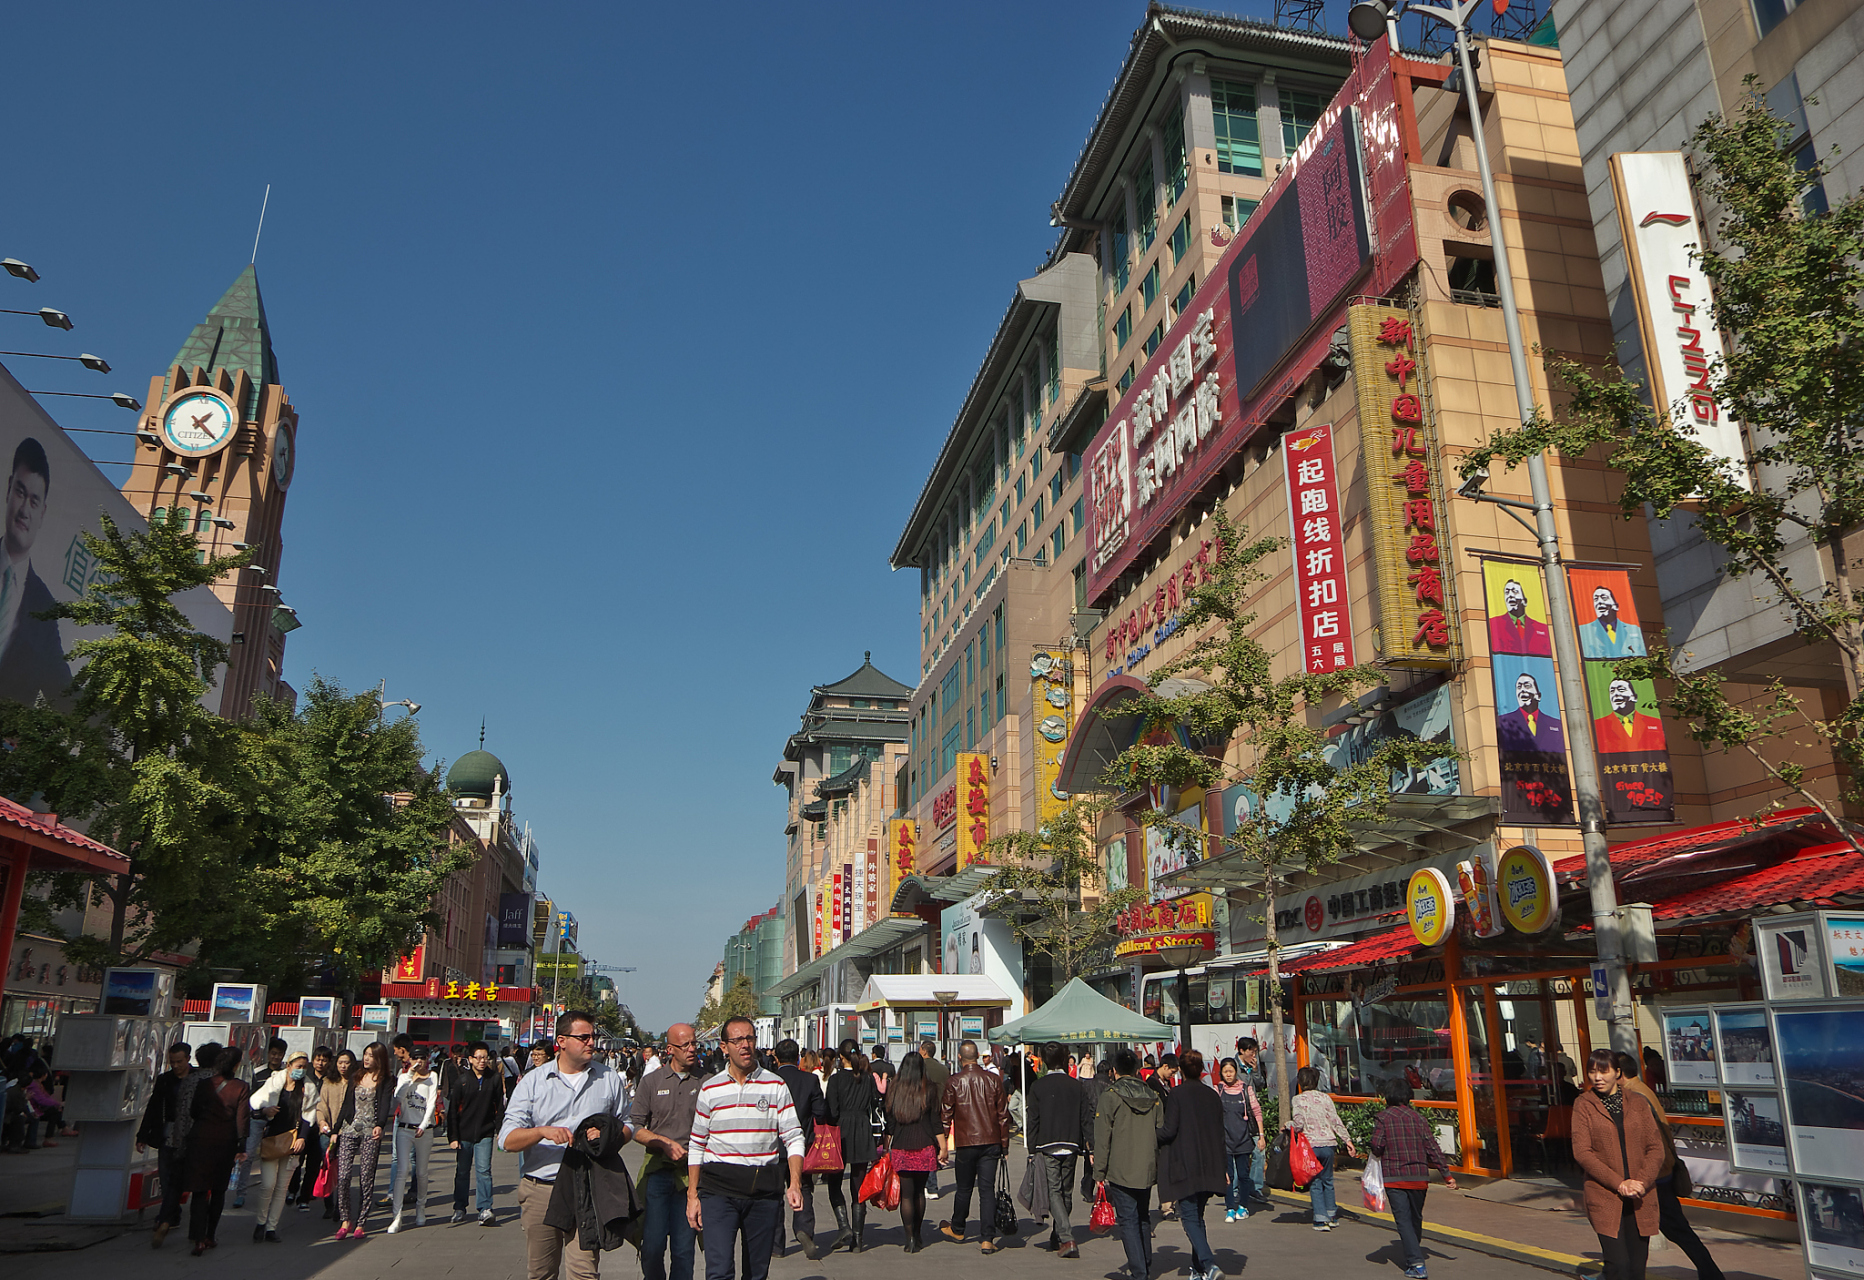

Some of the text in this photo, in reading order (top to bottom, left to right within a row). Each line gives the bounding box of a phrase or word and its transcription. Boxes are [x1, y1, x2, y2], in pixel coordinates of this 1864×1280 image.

[1666, 274, 1718, 427] LI-NING
[177, 430, 217, 440] CITIZE
[1376, 315, 1450, 648] 新中国儿童用品商店
[1297, 457, 1339, 639] 起跑线折扣店
[1526, 789, 1563, 807] 1955
[1626, 788, 1664, 806] 1955
[867, 862, 877, 893] 外婆家
[504, 908, 523, 920] Jaff
[443, 980, 500, 1002] 王老吉
